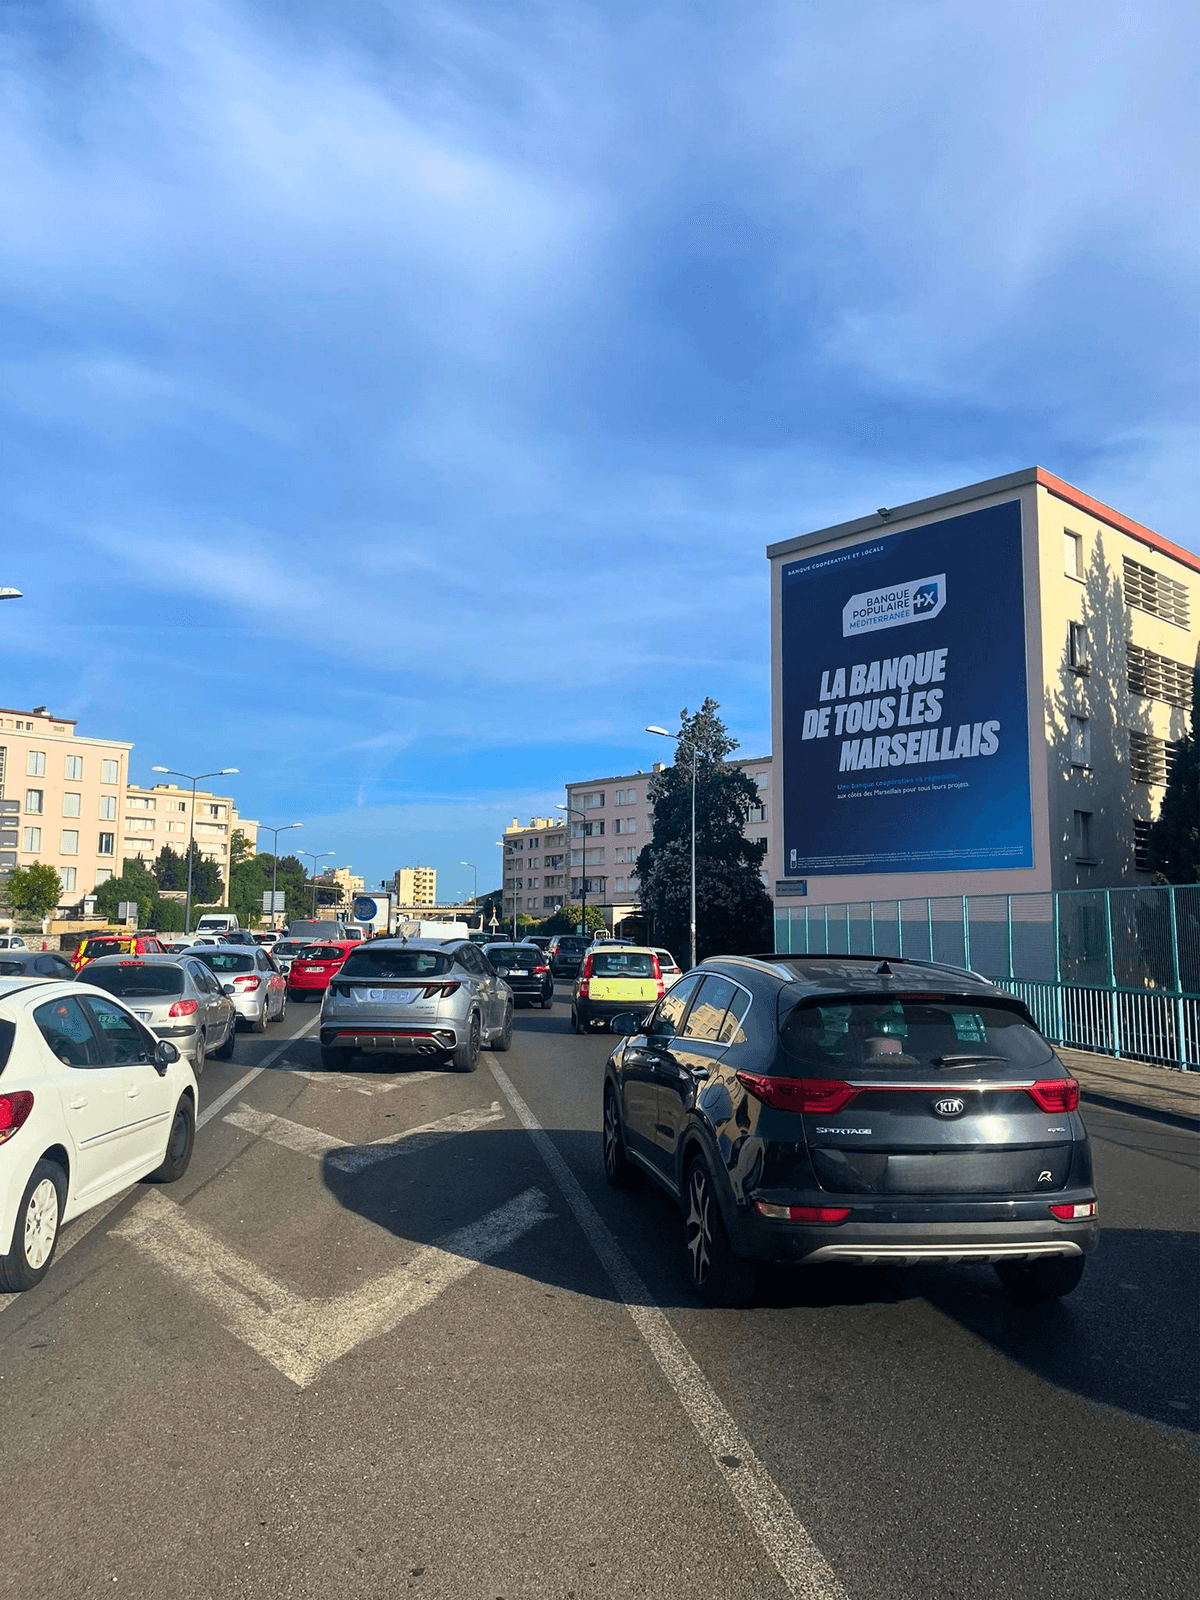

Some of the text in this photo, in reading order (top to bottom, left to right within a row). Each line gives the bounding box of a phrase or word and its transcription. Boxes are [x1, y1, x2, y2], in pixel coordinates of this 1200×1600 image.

[787, 565, 811, 576] BANQUE
[852, 551, 860, 559] ET
[861, 545, 884, 557] LOCALE
[866, 588, 910, 607] BANQUE
[852, 598, 910, 619] POPULAIRE
[849, 609, 911, 630] MÉDITERRANÉE
[819, 647, 949, 702] LA BANQUE
[801, 688, 944, 741] DE TOUS LES
[838, 719, 1001, 773] MARSEILLAIS
[873, 787, 902, 796] Marseillais
[902, 786, 917, 795] pour
[931, 783, 947, 791] leurs
[815, 1126, 873, 1135] SPORTAGE
